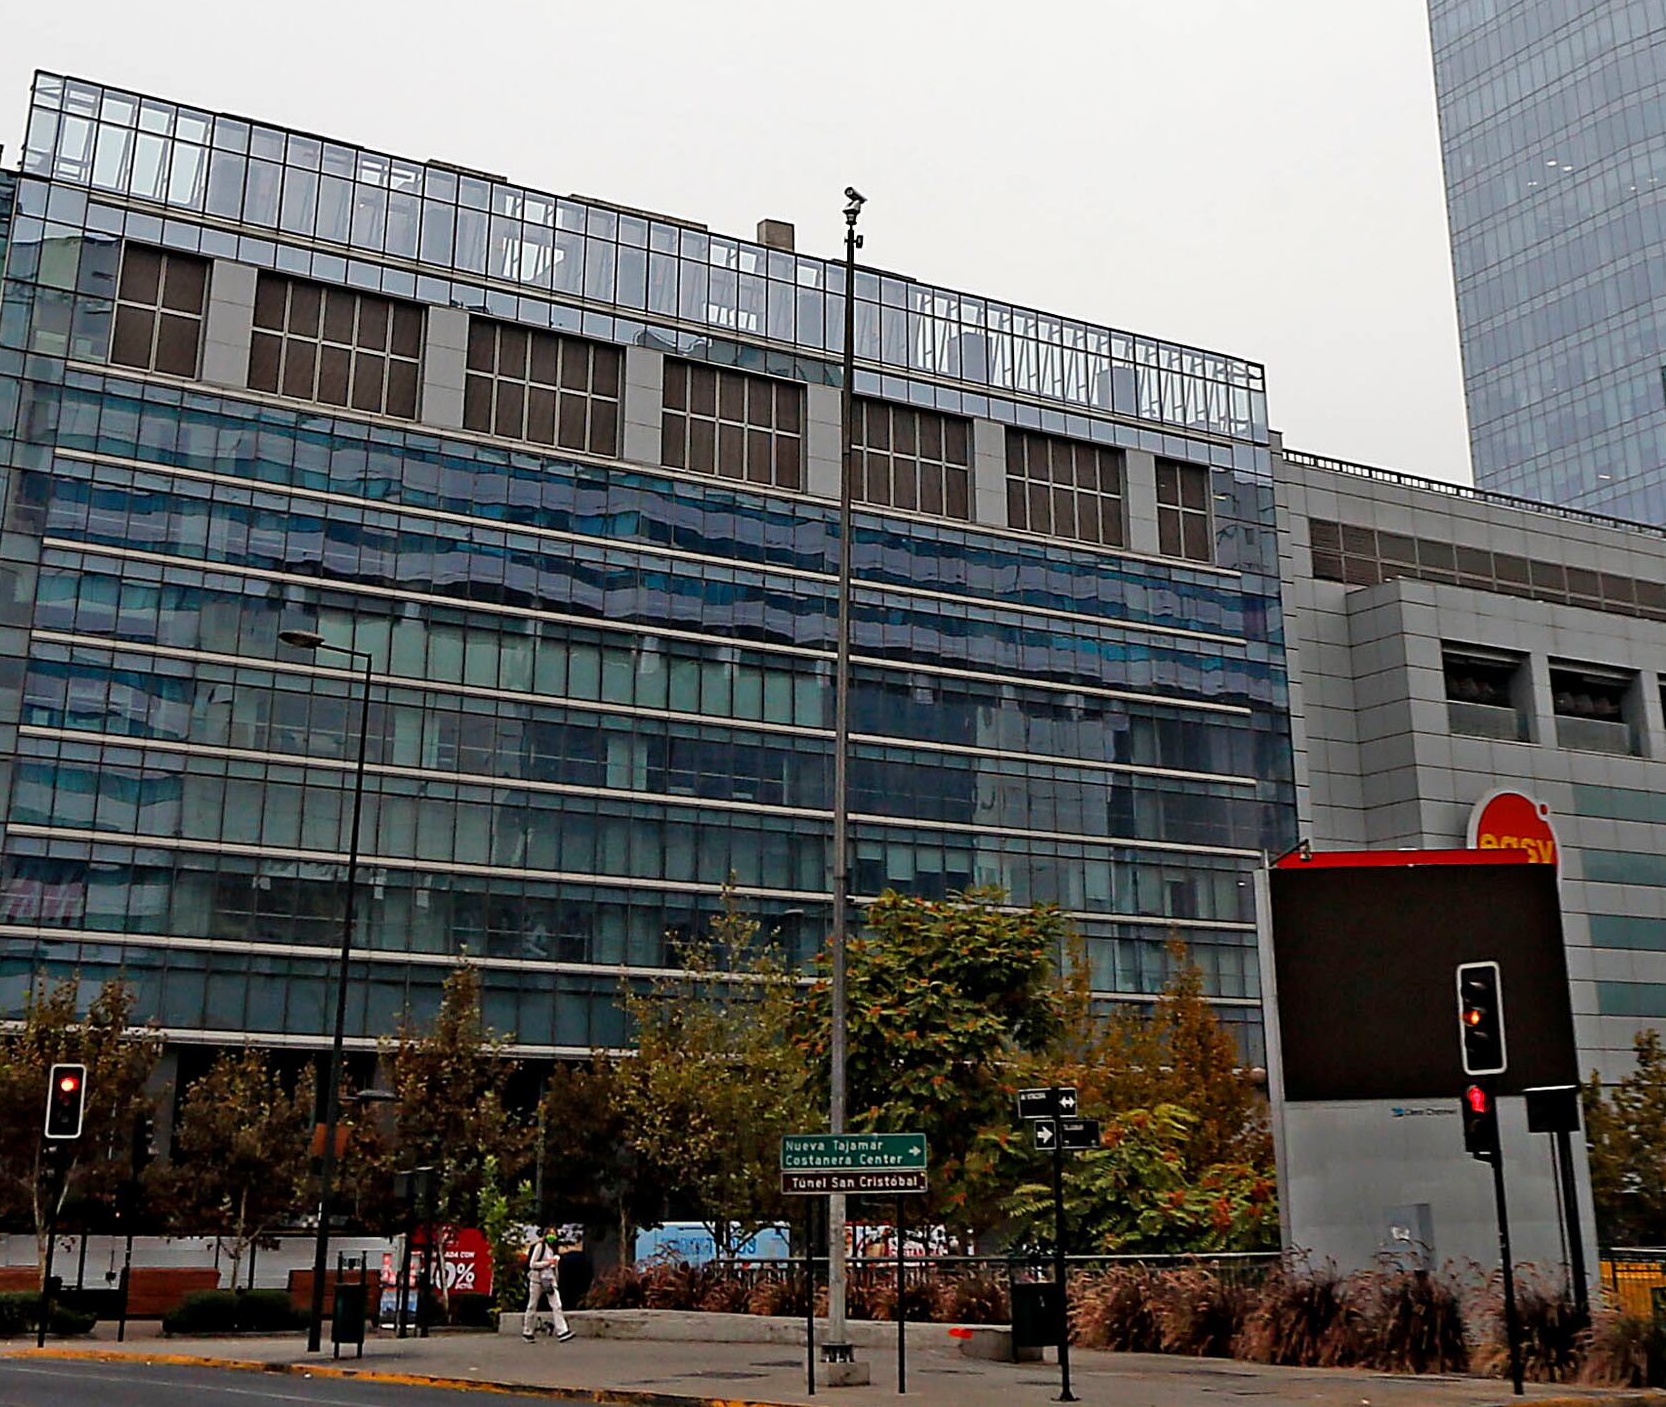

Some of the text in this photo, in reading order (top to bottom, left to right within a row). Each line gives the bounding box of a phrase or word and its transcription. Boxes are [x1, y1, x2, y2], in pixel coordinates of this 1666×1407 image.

[785, 1139, 884, 1154] Nueva Tajamar
[785, 1153, 904, 1166] Costanera Center
[831, 1177, 855, 1188] San
[859, 1175, 918, 1188] Cristóbal
